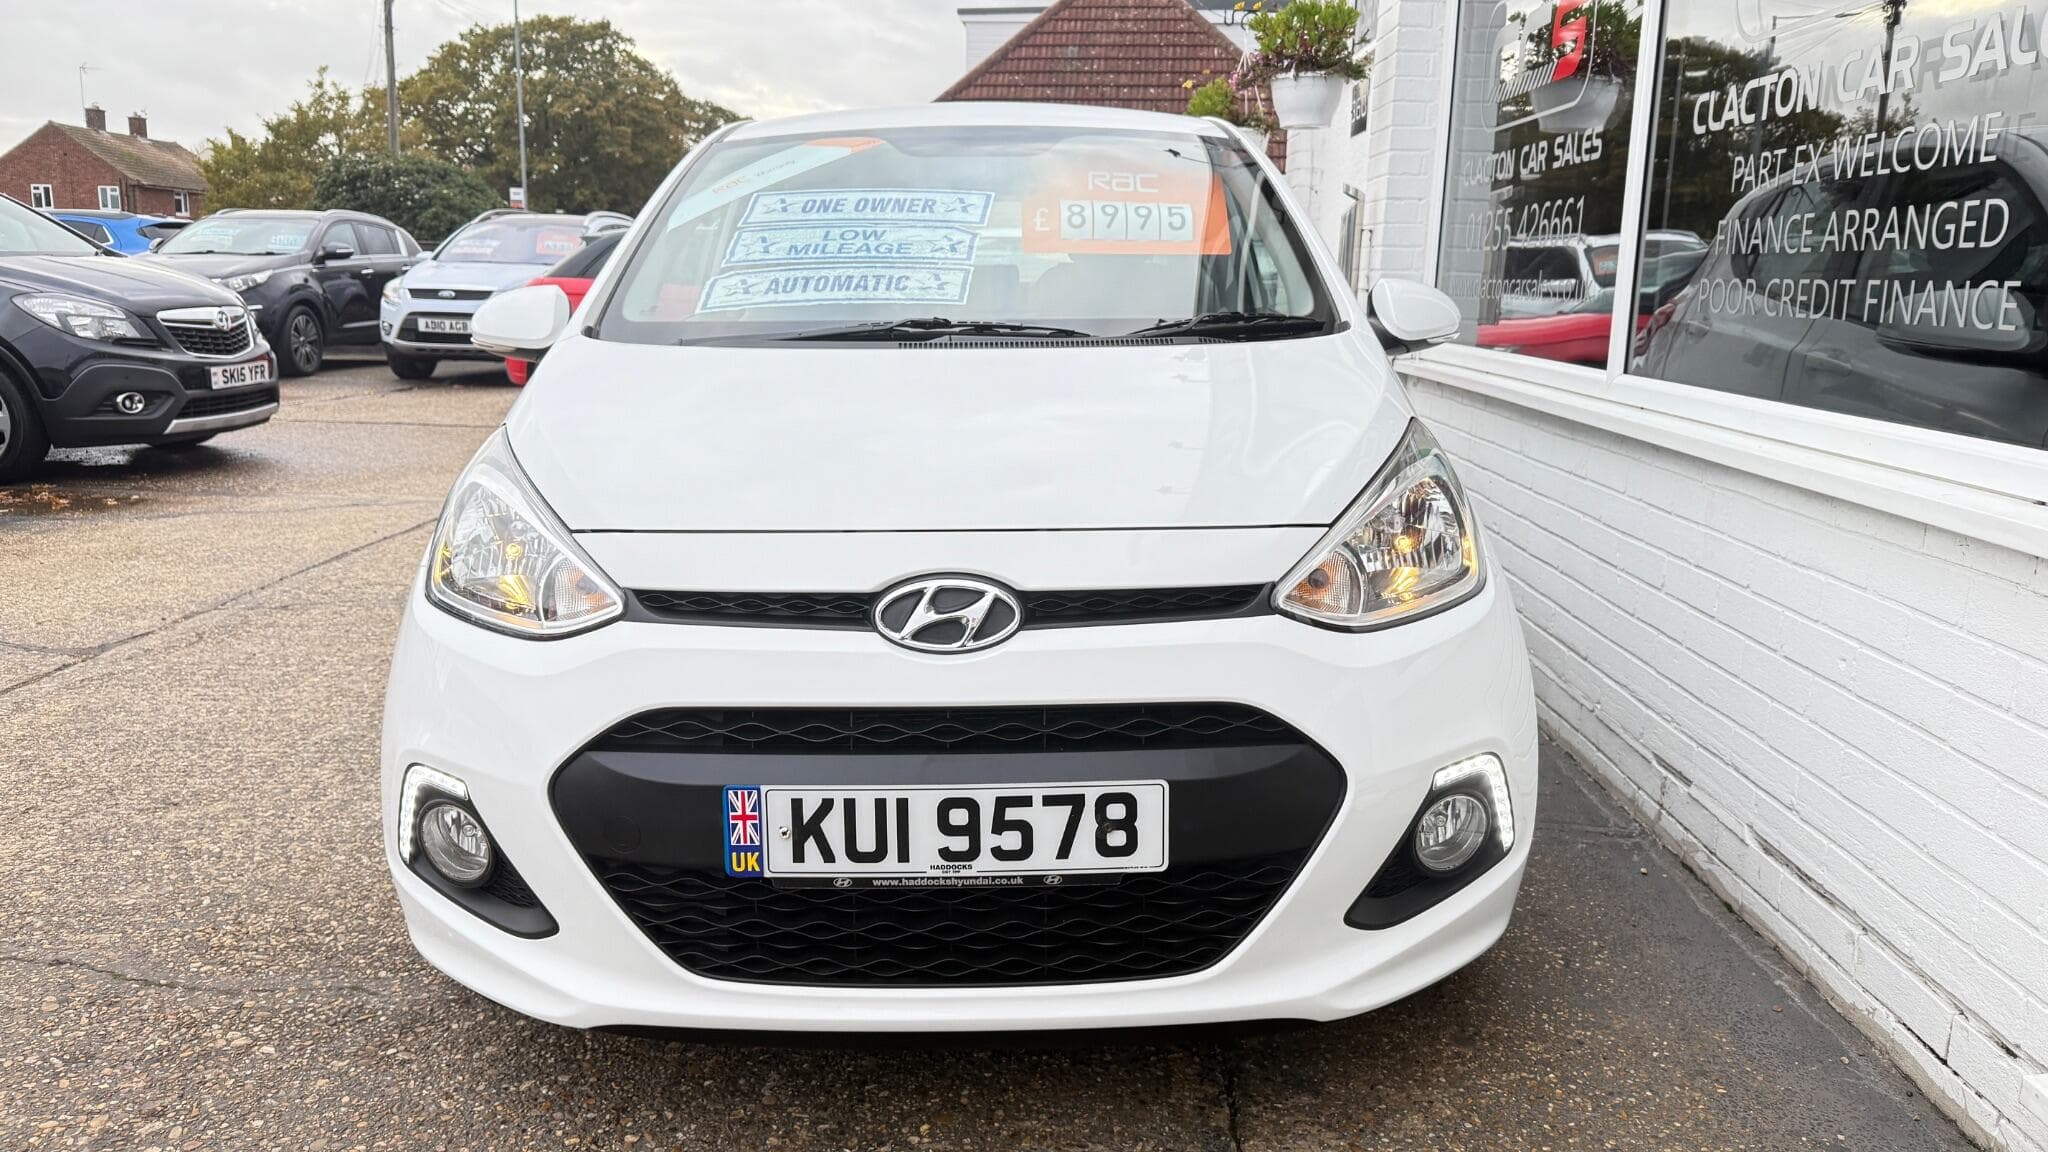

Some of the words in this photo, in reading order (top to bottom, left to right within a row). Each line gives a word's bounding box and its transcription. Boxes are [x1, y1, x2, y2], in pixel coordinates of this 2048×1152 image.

[1693, 61, 1824, 135] CLACTON
[1837, 34, 1920, 103] CAR
[1938, 4, 2048, 83] SAL
[1463, 149, 1515, 186] CLACTON
[1519, 140, 1549, 175] CAR
[1552, 126, 1603, 169] SALES
[1730, 148, 1787, 194] PART
[1791, 140, 1826, 185] EX
[1832, 110, 2004, 180] WELCOME
[801, 198, 846, 214] ONE
[853, 198, 937, 214] OWNER
[1033, 208, 1050, 232] £
[1067, 204, 1186, 231] 8995
[822, 229, 887, 241] LOW
[1465, 207, 1514, 252] 01255
[1516, 195, 1585, 249] 426661
[1715, 212, 1816, 256] FINANCE
[1820, 198, 2010, 252] ARRANGED
[786, 243, 912, 256] MILEAGE
[764, 274, 909, 296] AUTOMATIC
[1697, 278, 1757, 315] POOR
[1763, 278, 1857, 320] CREDIT
[1862, 279, 2022, 331] FINANCE
[222, 367, 246, 384] SK15
[248, 364, 266, 381] YFR
[790, 797, 911, 864] KUI
[936, 792, 1139, 864] 9578
[731, 851, 760, 872] UK
[929, 863, 973, 871] HADDOCKS
[872, 876, 1024, 887] www.haddockshyundai.co.uk
